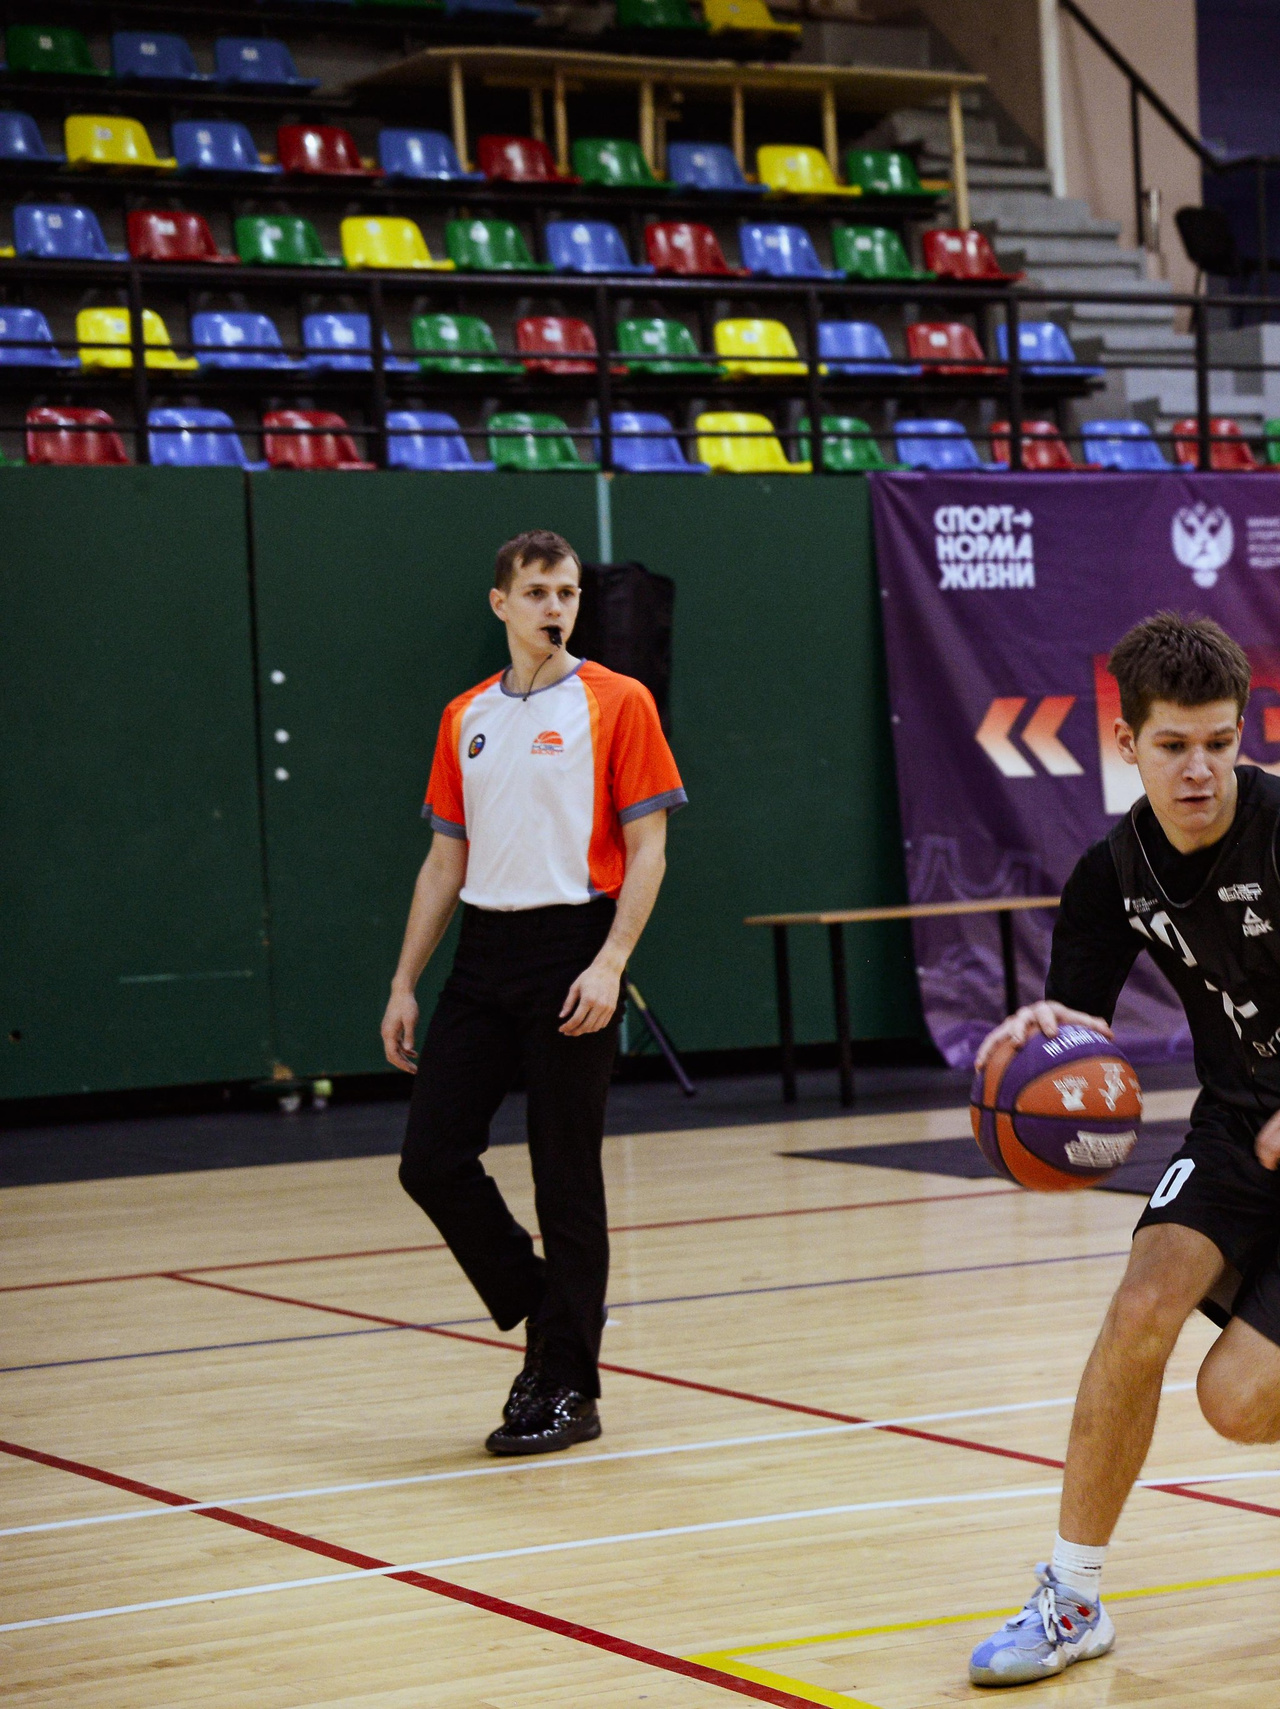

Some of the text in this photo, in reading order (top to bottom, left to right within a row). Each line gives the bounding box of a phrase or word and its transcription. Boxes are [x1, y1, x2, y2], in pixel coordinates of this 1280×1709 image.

[934, 504, 1015, 533] СПОРТ
[936, 532, 1033, 561] НОРМА
[938, 561, 1035, 590] ЖИЗНИ
[1149, 1158, 1196, 1209] 0
